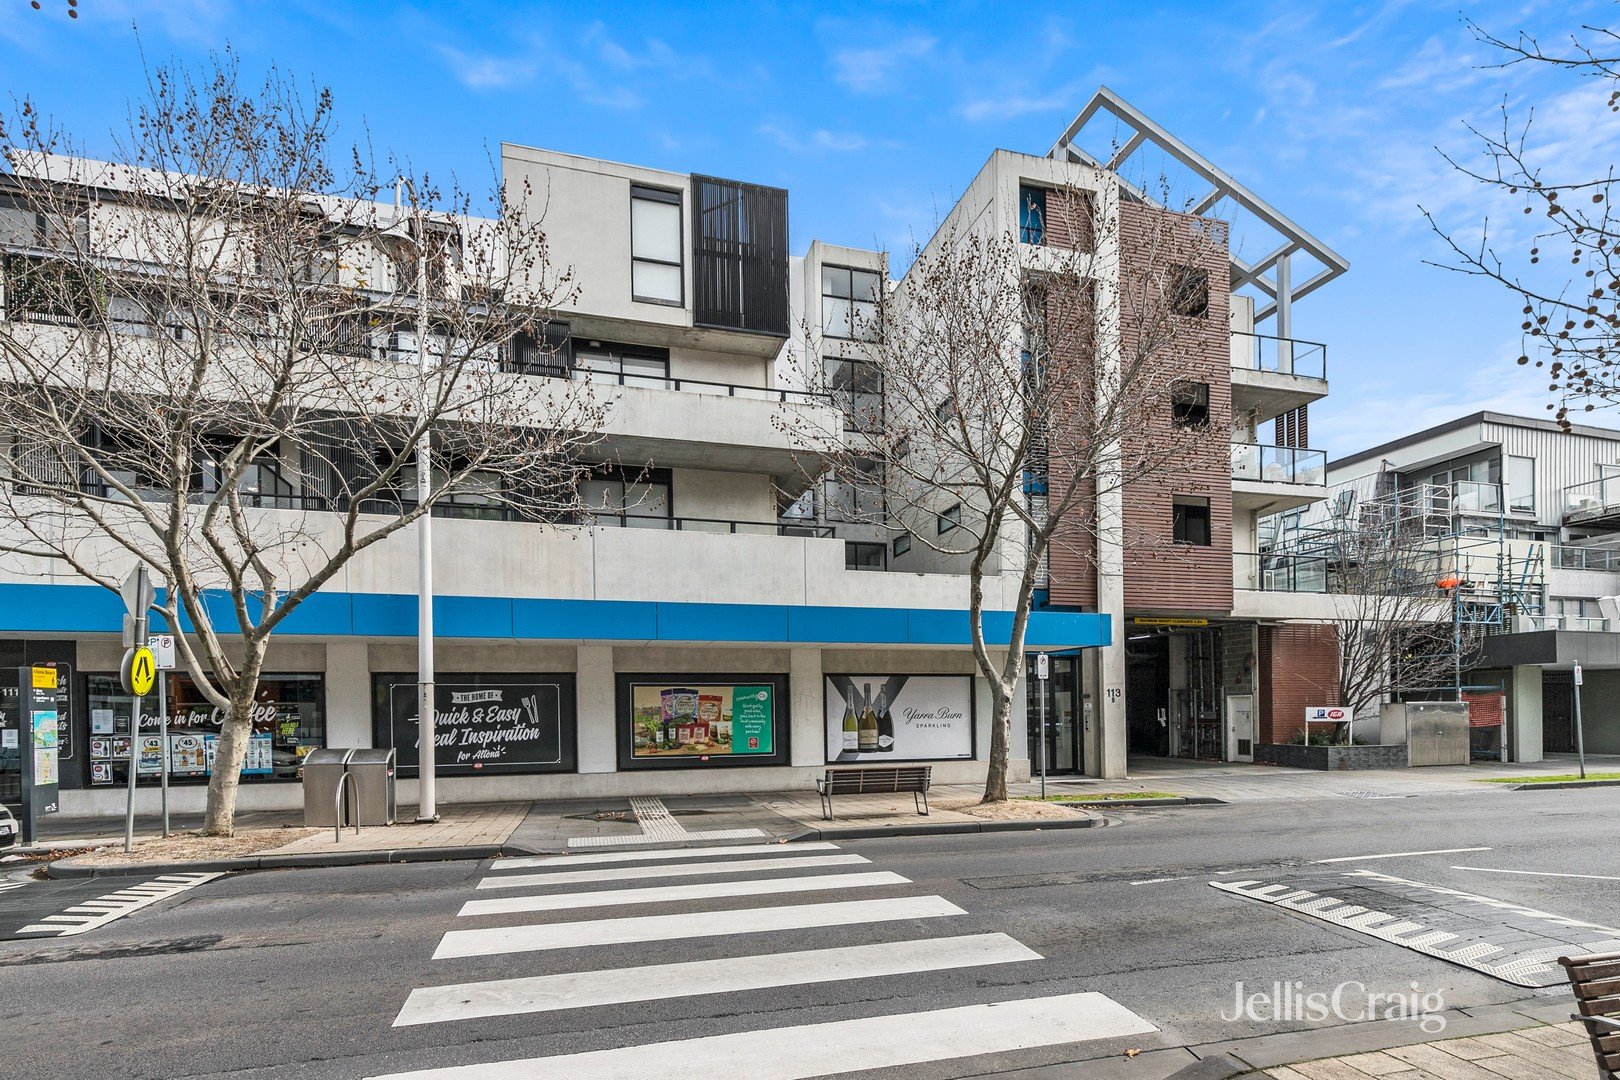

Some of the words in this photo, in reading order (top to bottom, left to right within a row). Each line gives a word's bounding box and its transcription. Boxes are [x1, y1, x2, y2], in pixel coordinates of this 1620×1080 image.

[1107, 689, 1121, 697] 113
[174, 710, 186, 724] in
[188, 711, 208, 727] for
[472, 708, 484, 723] &
[486, 706, 521, 724] Easy
[903, 707, 935, 725] Yarra
[935, 707, 963, 720] Burn
[415, 728, 458, 748] eal
[458, 723, 540, 748] Inspiration
[457, 751, 470, 762] for
[472, 750, 500, 760] Altona
